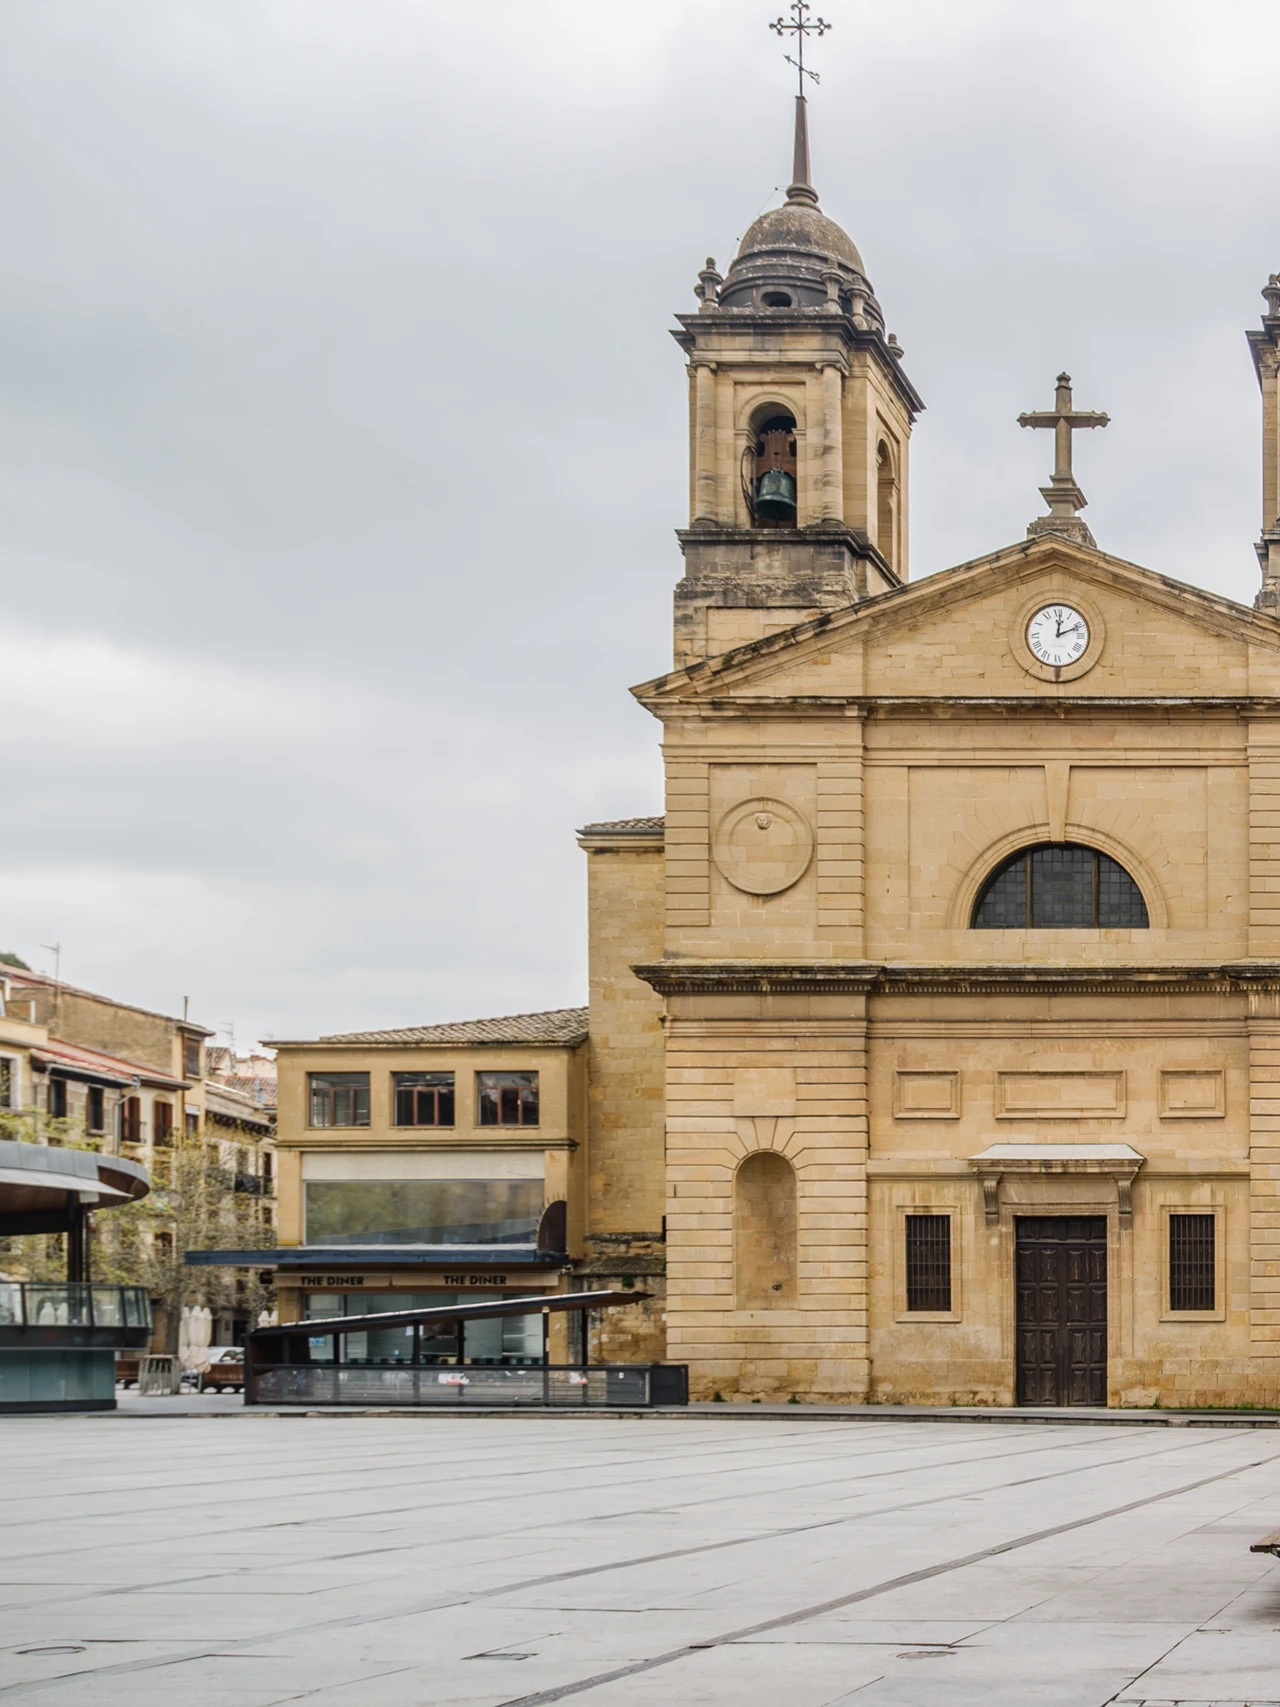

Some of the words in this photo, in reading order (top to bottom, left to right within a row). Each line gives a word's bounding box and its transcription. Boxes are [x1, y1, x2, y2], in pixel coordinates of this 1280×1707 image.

[301, 1276, 323, 1286] THE
[327, 1275, 364, 1286] DINER
[444, 1275, 468, 1285] THE
[470, 1275, 507, 1285] DINER
